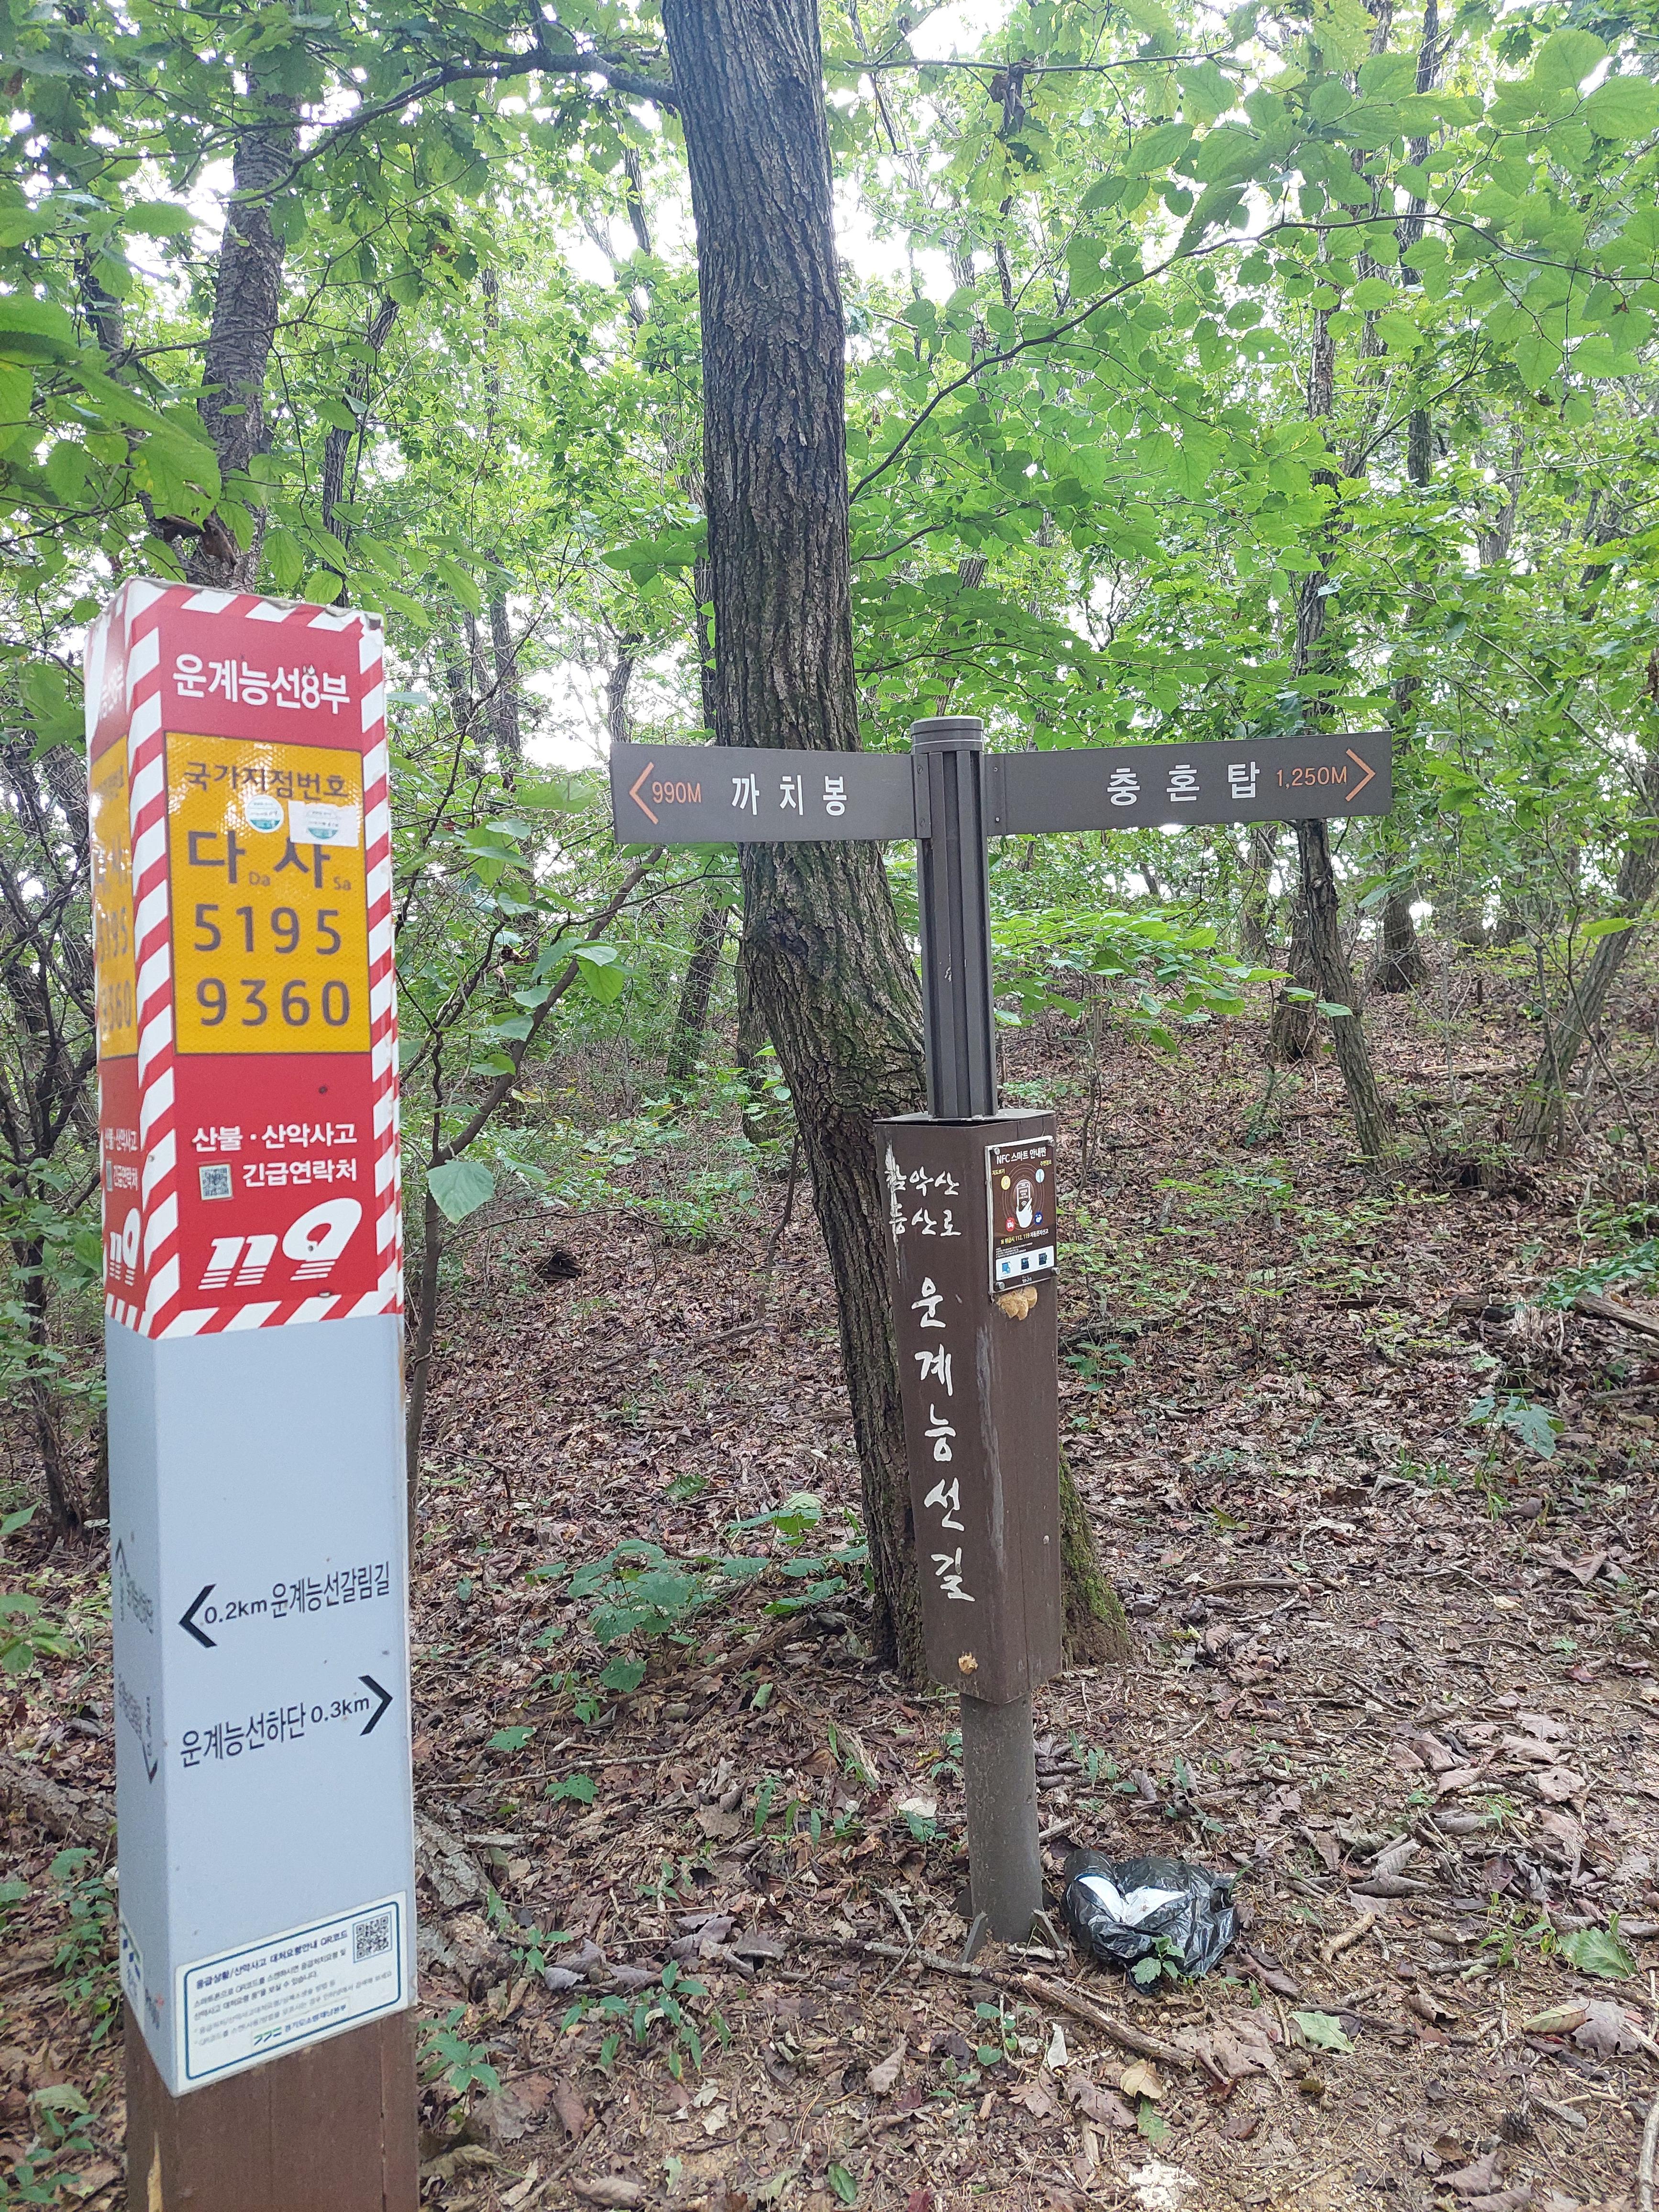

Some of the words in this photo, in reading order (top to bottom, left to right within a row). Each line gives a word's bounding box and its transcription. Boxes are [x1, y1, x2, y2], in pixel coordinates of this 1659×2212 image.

[172, 653, 350, 715] 운계능선8부
[183, 762, 348, 800] 국가지점번호
[652, 781, 701, 804] 990M
[1276, 765, 1348, 790] 1,250M
[188, 830, 246, 884] 다
[194, 903, 342, 955] 5195
[196, 977, 350, 1027] 9360
[242, 1159, 357, 1187] 긴급연락처
[996, 1154, 1010, 1164] NFC
[1010, 1150, 1029, 1161] 스마트
[1029, 1147, 1047, 1159] 안내판
[198, 1197, 363, 1290] 119
[888, 1203, 962, 1237] 등산로
[109, 1207, 141, 1286] 119
[270, 1561, 389, 1619] 운계능선갈림길
[180, 1702, 306, 1768] 운계능선하단
[310, 1696, 370, 1724] 0.3km
